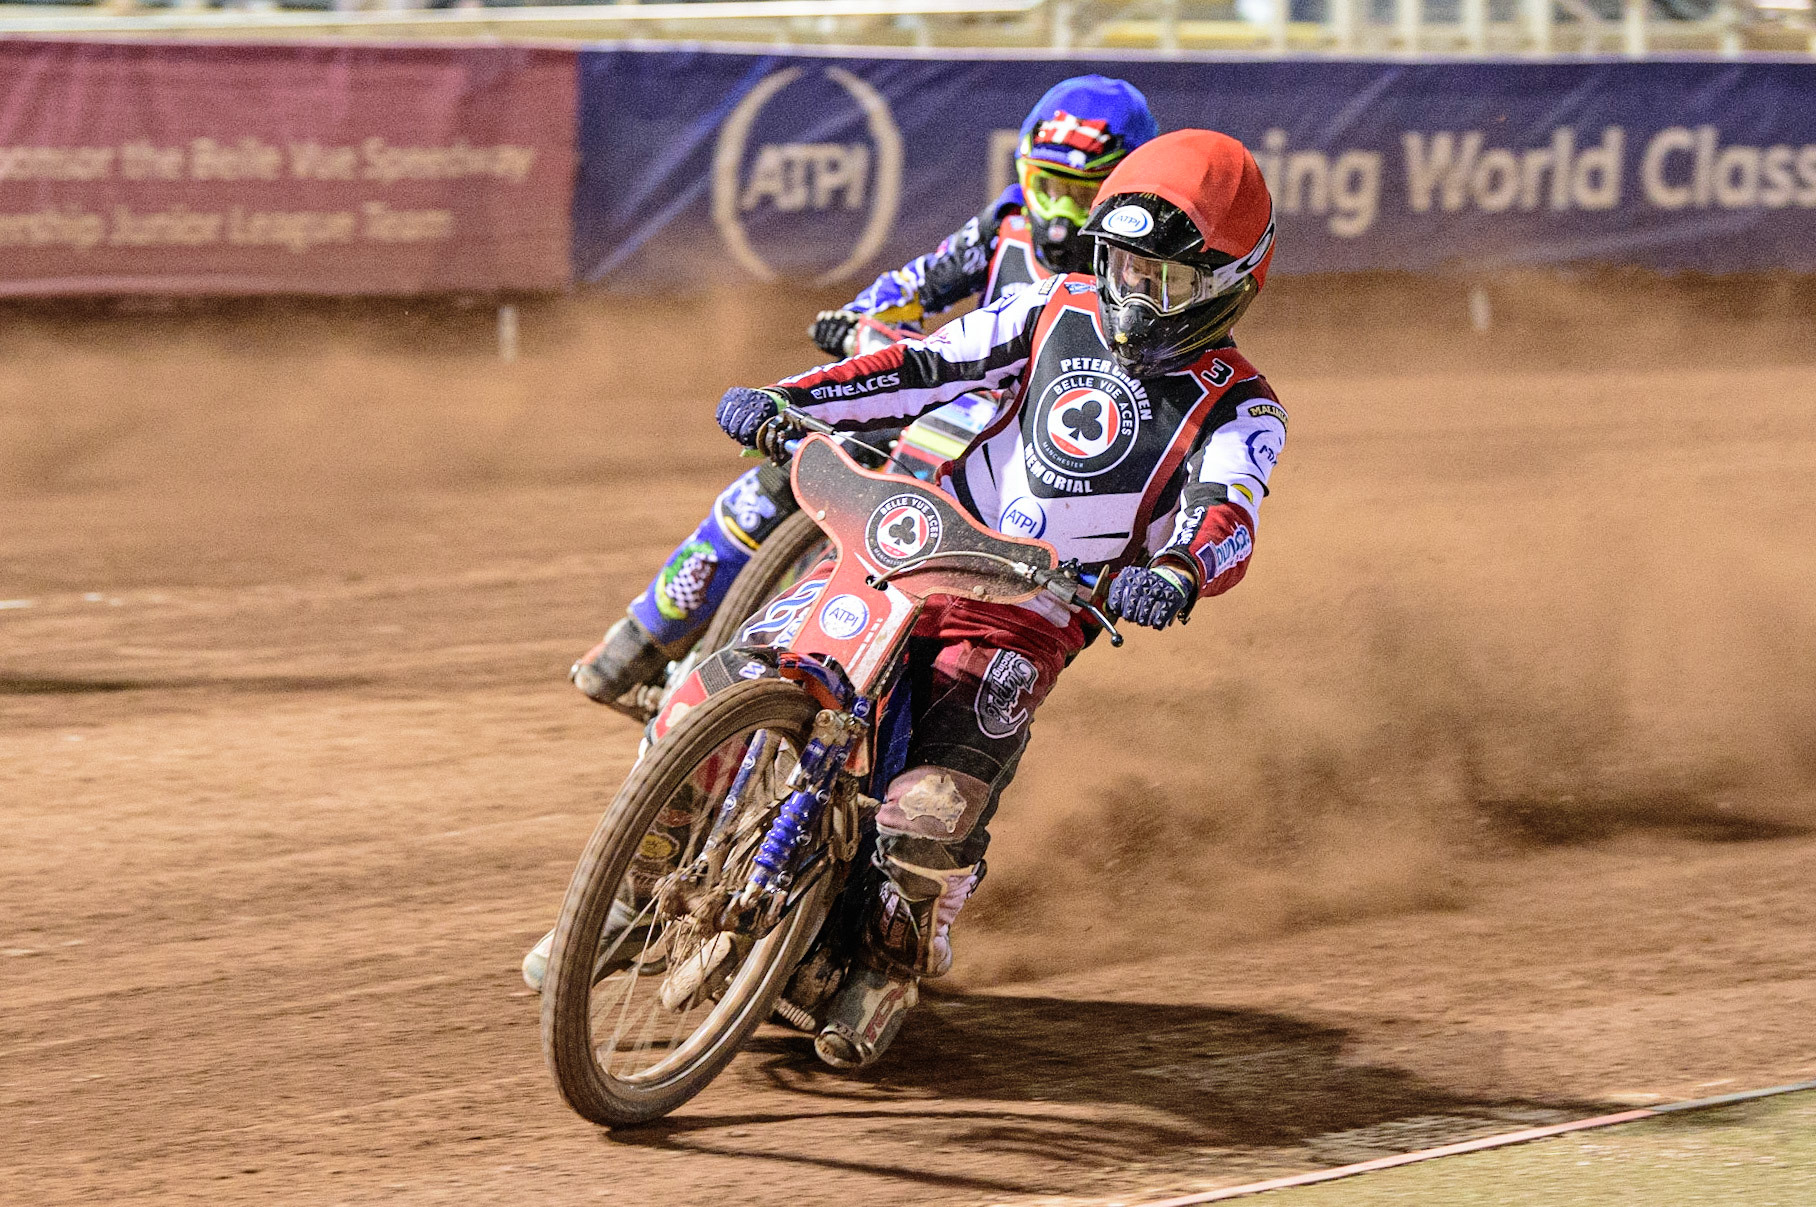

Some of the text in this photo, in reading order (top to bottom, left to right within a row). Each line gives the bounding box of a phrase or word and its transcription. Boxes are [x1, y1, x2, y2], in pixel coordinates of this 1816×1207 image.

[742, 143, 870, 213] ATPI
[1402, 125, 1626, 213] World
[1641, 123, 1816, 209] Class
[1060, 357, 1113, 373] PETER
[1201, 358, 1235, 388] 3
[1052, 376, 1134, 437] BELLE VUE ACES
[1024, 442, 1094, 494] MEMORIAL
[1042, 441, 1085, 469] MANCHESTER
[880, 497, 939, 539] BELLE VUE ACES
[1005, 508, 1038, 534] ATPI
[828, 607, 860, 627] ATPI
